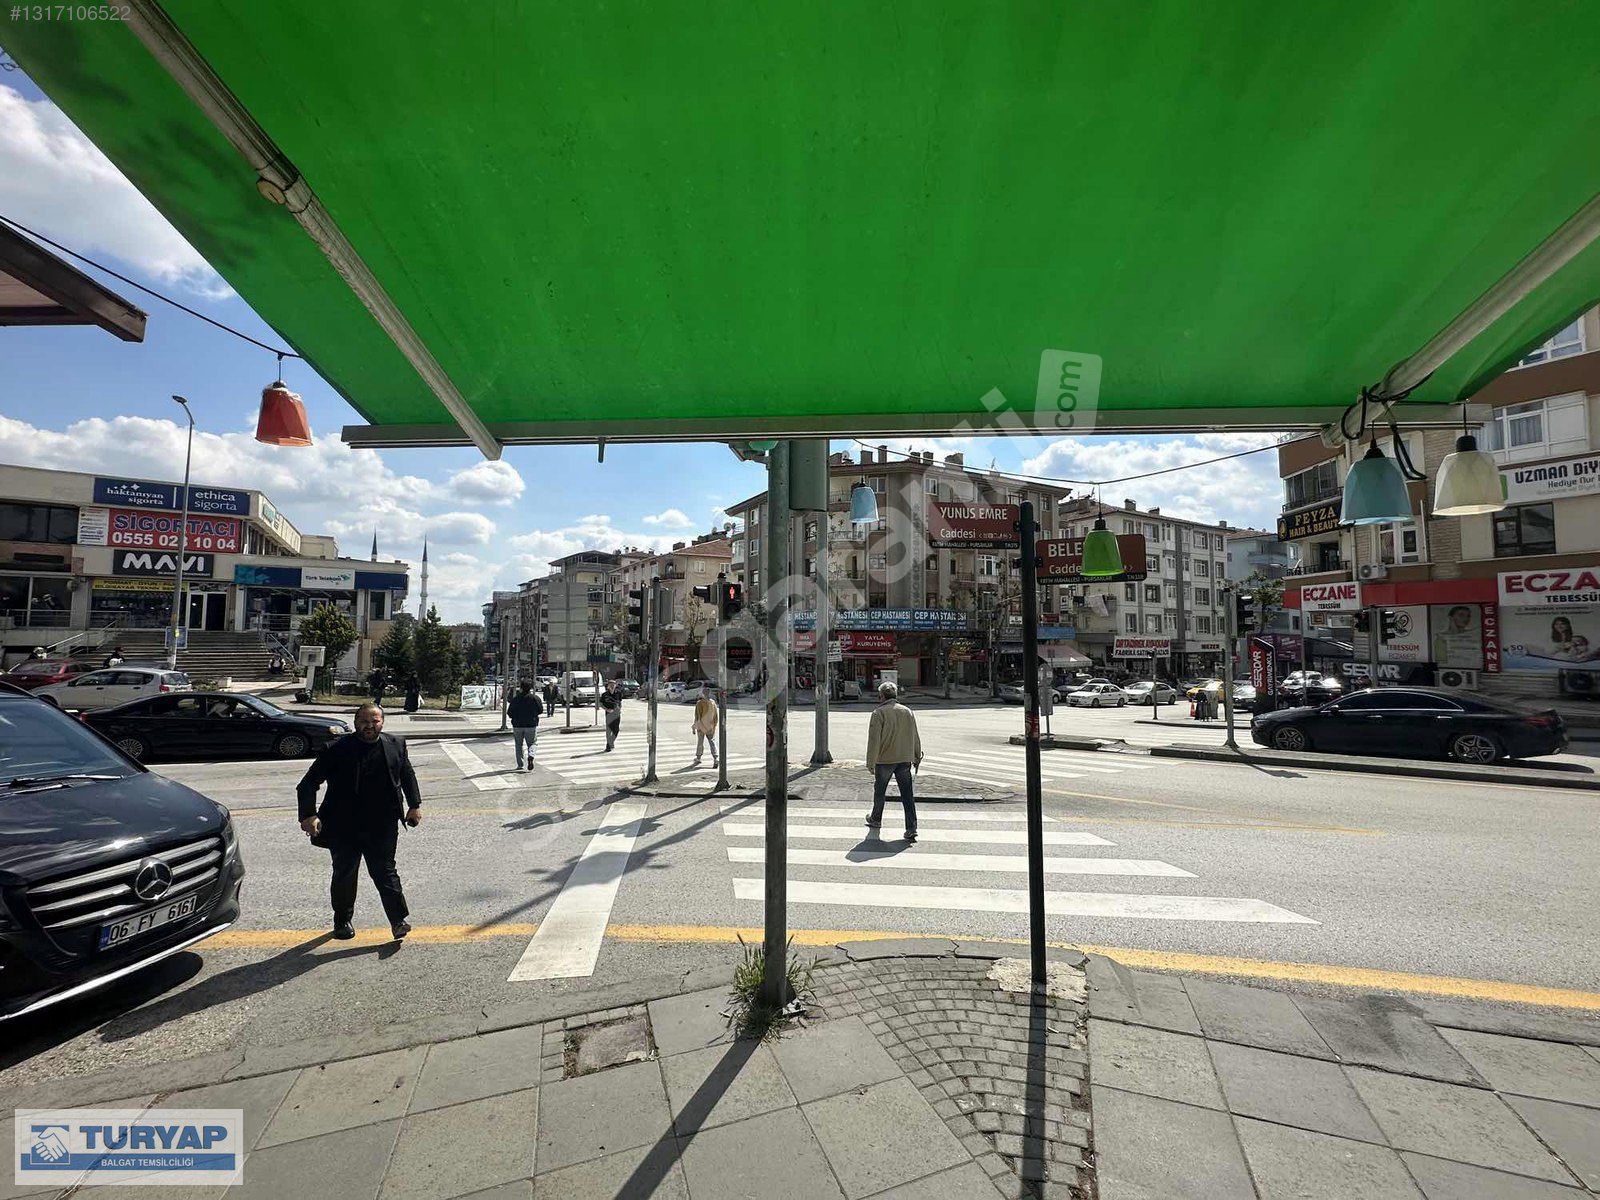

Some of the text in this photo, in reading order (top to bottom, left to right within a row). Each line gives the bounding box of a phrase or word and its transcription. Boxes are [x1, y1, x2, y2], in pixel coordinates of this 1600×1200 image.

[1514, 460, 1600, 484] UZMAN DİY
[1548, 479, 1577, 488] Hediye
[128, 497, 164, 506] sigorta
[195, 491, 236, 501] ethica
[194, 500, 237, 511] sigorta
[940, 507, 1008, 520] YUNUS EMRE
[1295, 506, 1336, 526] FEYZA
[114, 512, 236, 537] SİGORTACI
[1289, 519, 1340, 538] HAIR & BEAUT
[112, 531, 154, 546] 0555
[194, 538, 212, 549] 10
[217, 539, 236, 550] 04
[940, 528, 976, 539] Caddesi
[1047, 542, 1082, 557] BELE
[1049, 563, 1081, 574] Cadde
[1303, 585, 1356, 601] ECZANE
[794, 611, 818, 620] HASTANE
[871, 611, 881, 619] CEP
[1484, 607, 1497, 671] ECZANE
[1253, 651, 1263, 687] SERDAR
[109, 898, 196, 940] 06 FY 6161
